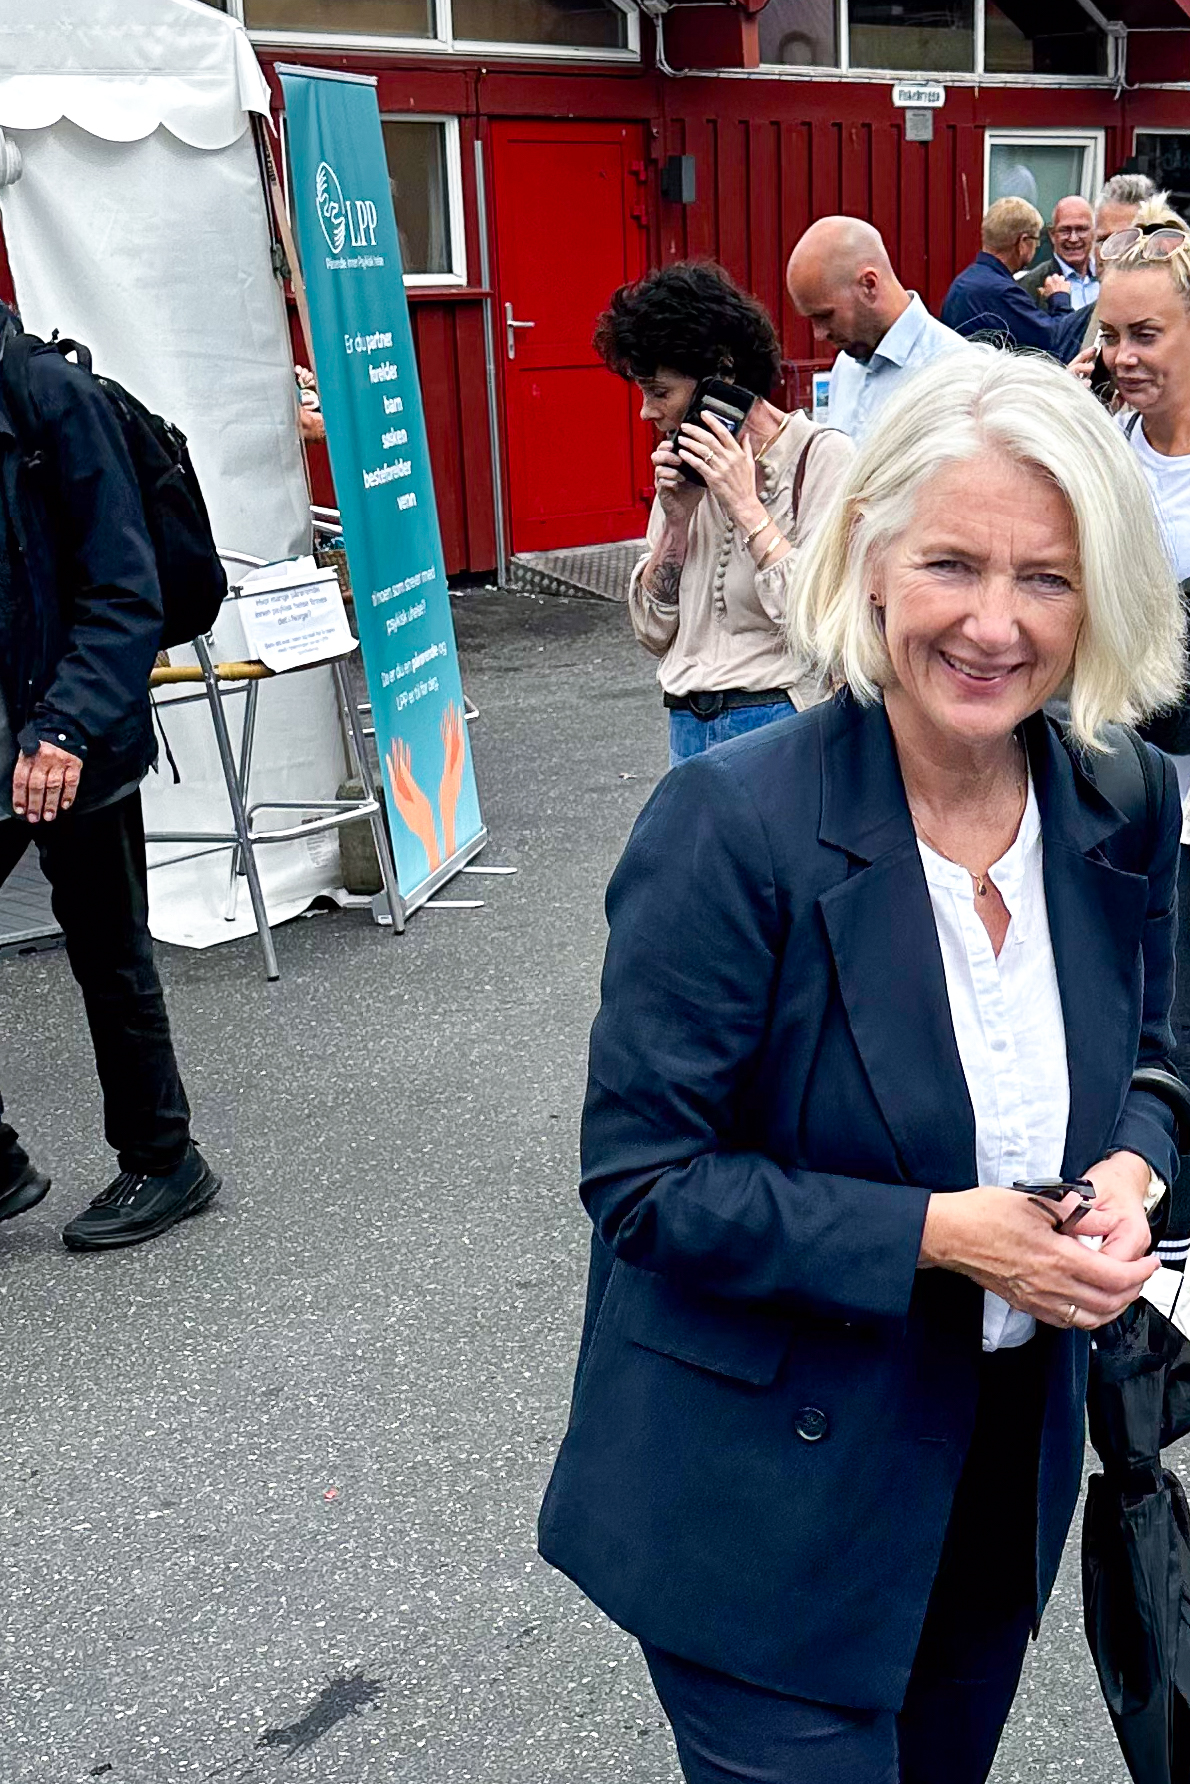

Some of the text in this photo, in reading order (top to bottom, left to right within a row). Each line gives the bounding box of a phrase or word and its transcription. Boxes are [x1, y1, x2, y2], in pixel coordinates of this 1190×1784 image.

[346, 200, 377, 246] LPP
[344, 331, 393, 355] Er du partner
[383, 394, 403, 414] barn
